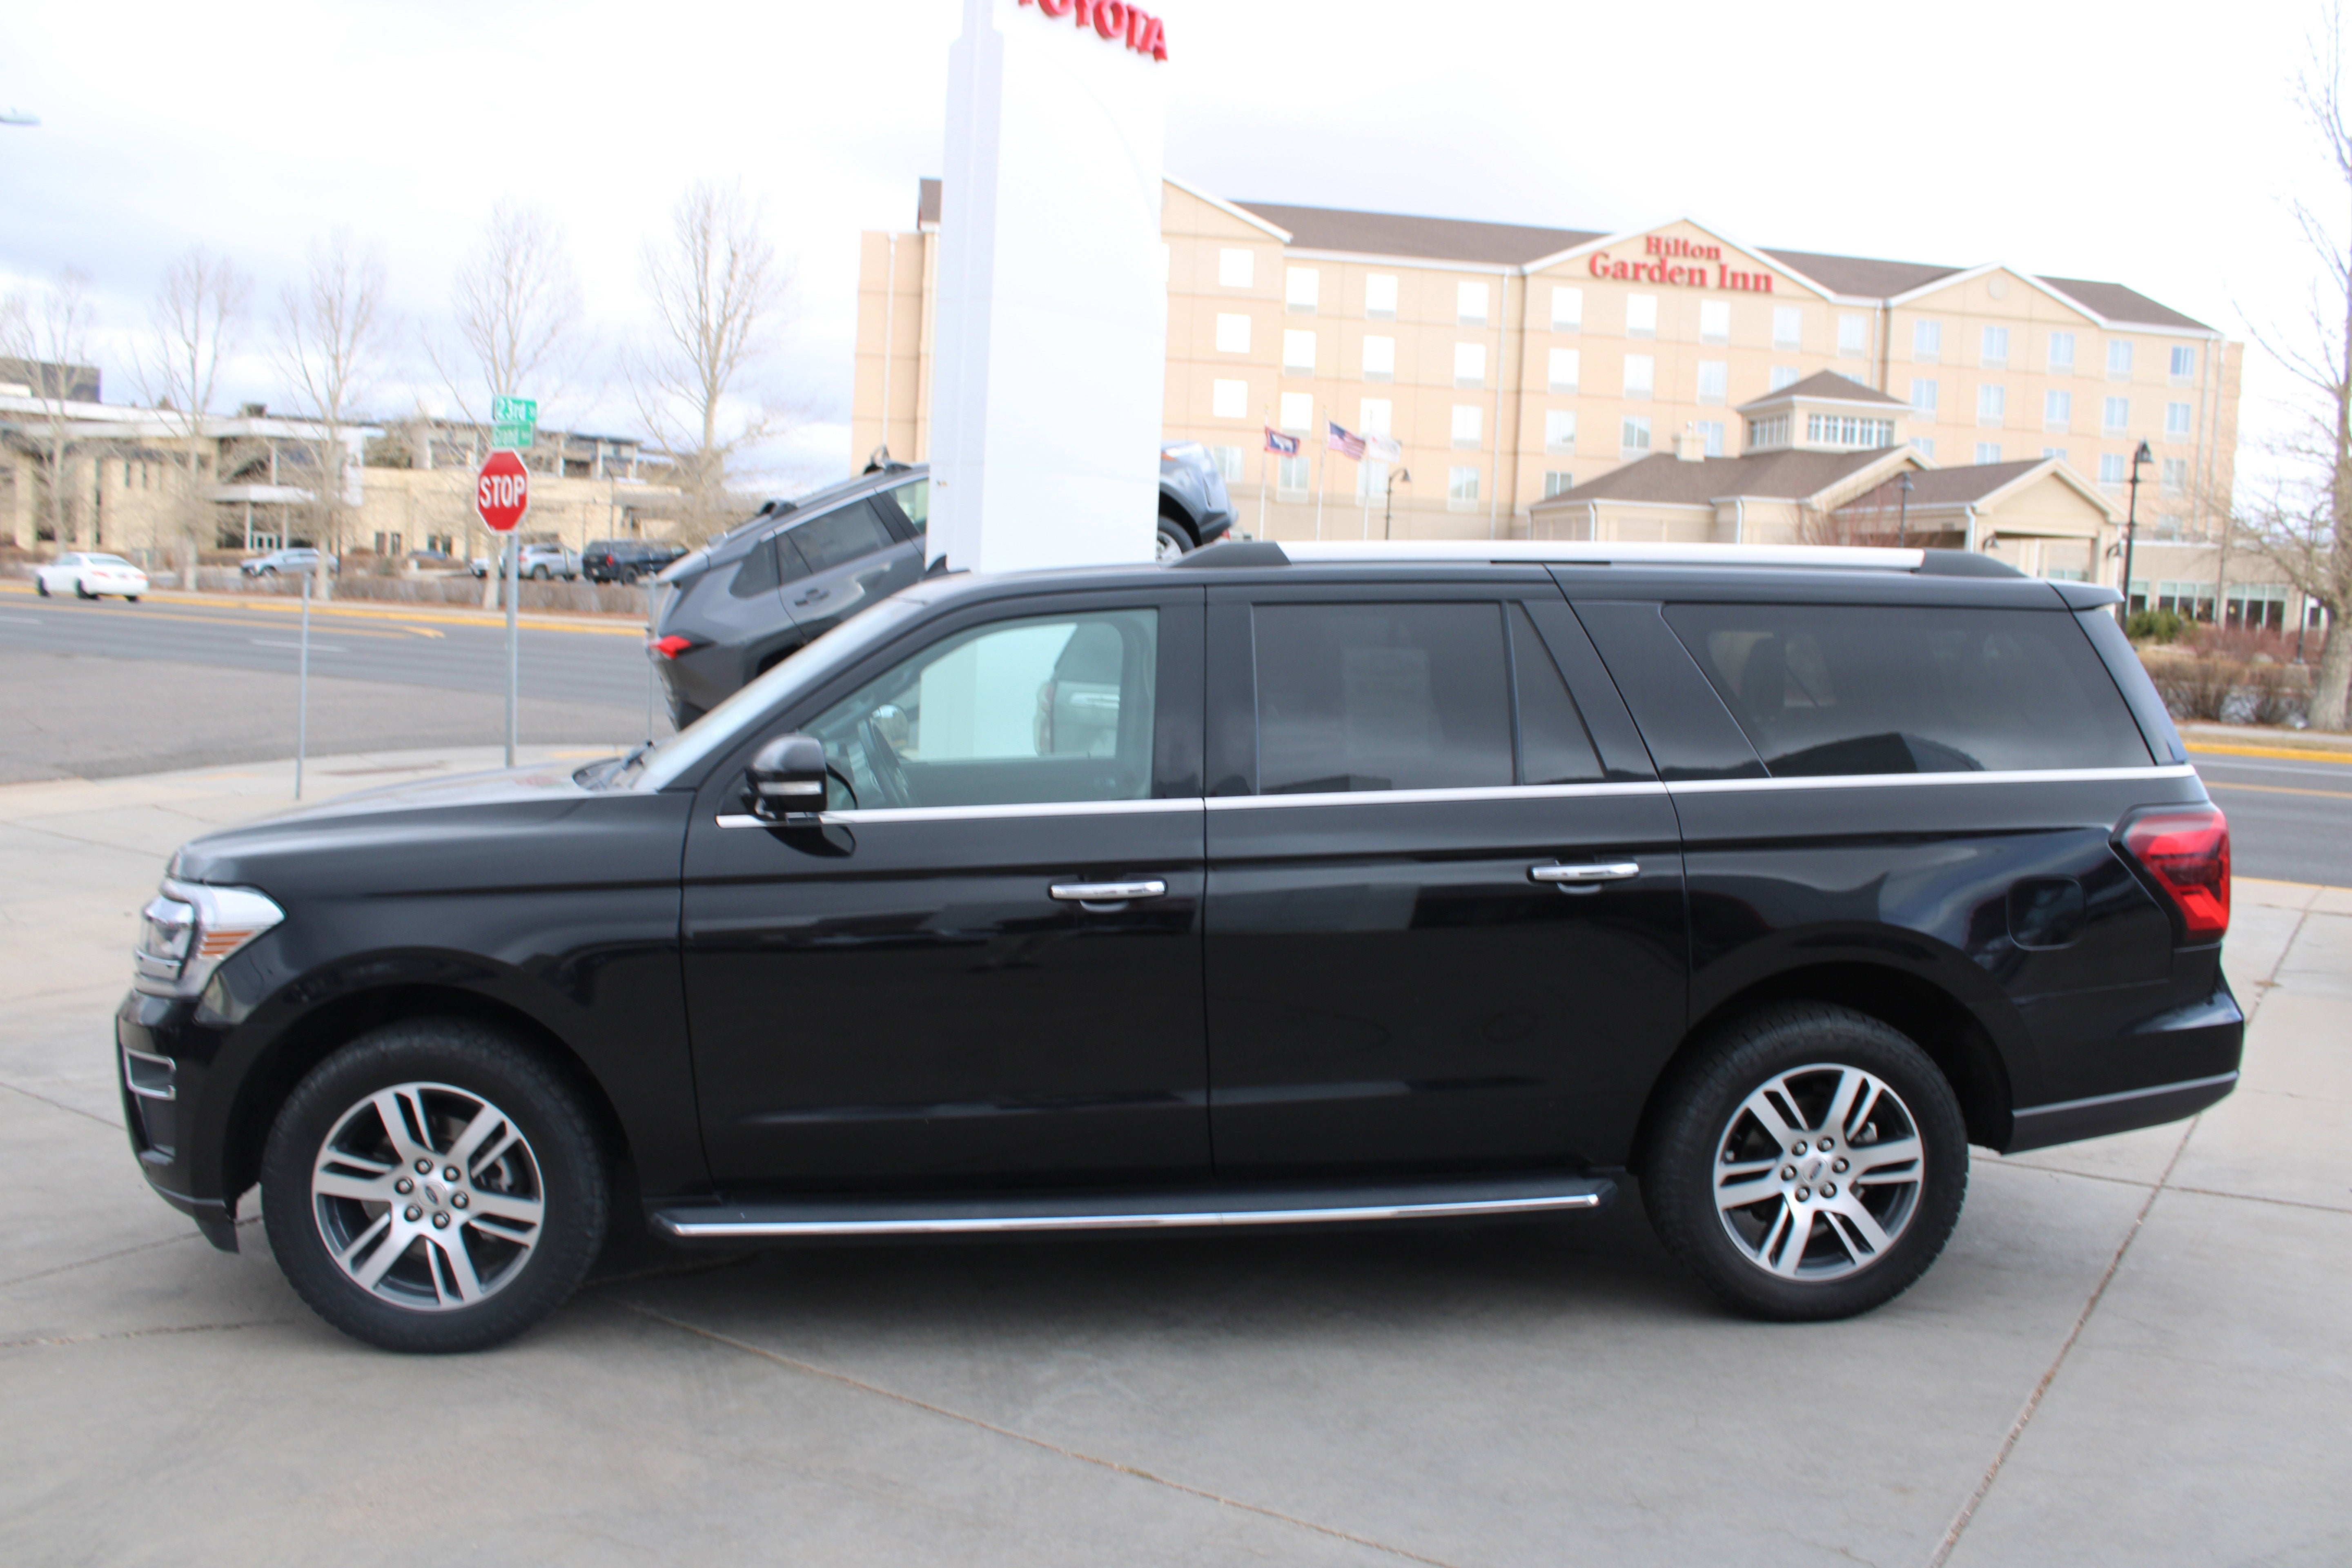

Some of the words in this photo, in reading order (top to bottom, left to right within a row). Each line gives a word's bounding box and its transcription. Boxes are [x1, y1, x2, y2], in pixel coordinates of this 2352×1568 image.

[1019, 0, 1168, 62] YOTA
[1646, 234, 1722, 261] Hilton
[1589, 250, 1708, 287] Garden
[1718, 263, 1773, 293] Inn
[496, 397, 526, 421] 23rd
[479, 474, 525, 508] STOP
